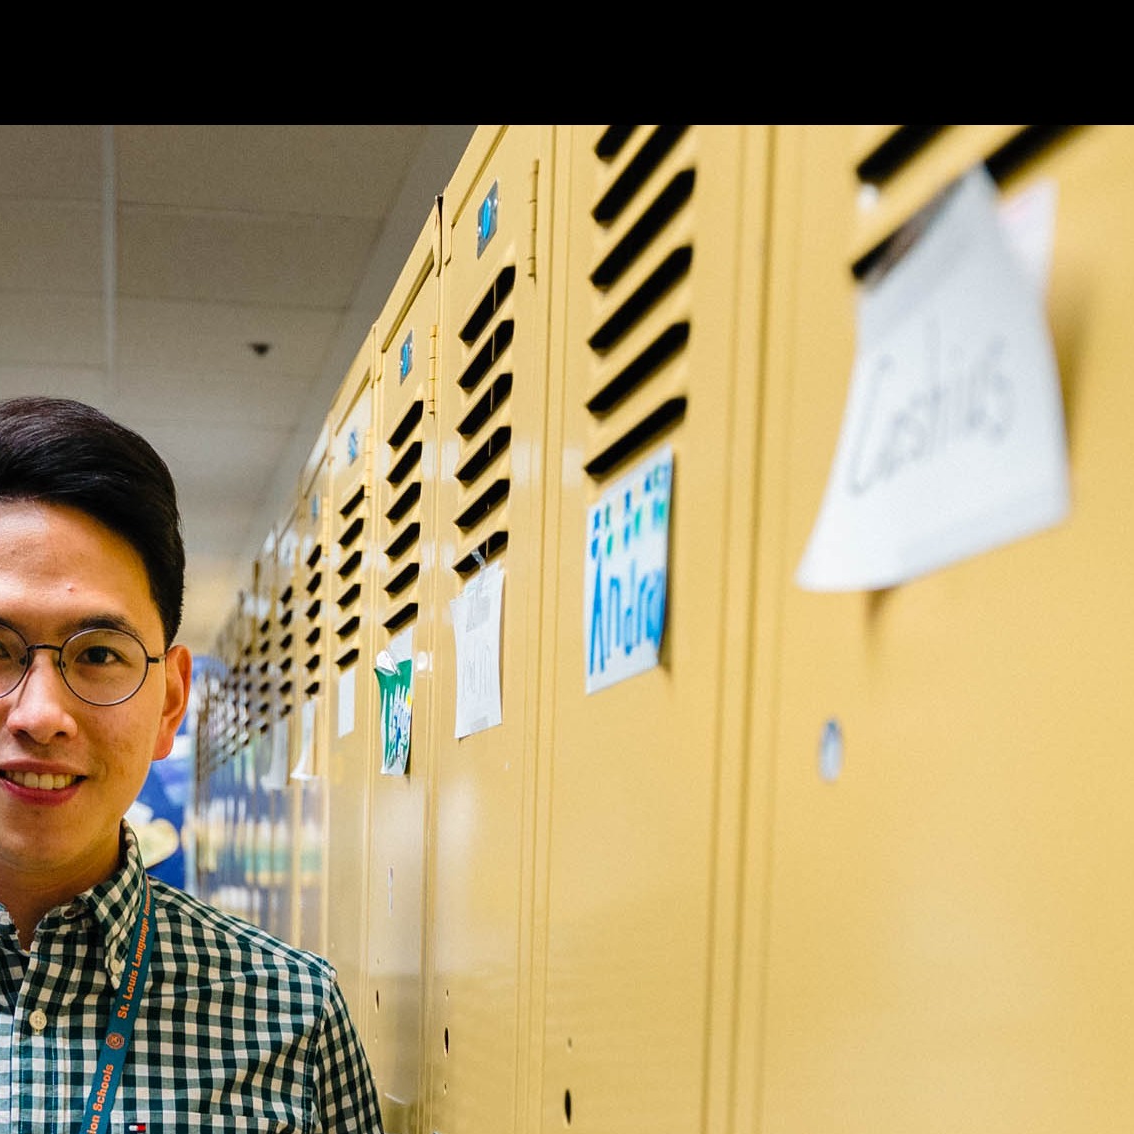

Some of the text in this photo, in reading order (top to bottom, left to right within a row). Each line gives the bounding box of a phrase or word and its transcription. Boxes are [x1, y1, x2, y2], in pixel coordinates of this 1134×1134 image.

[136, 917, 150, 968] Language
[123, 970, 138, 1000] Louis
[117, 1004, 130, 1019] St.
[93, 1064, 113, 1111] Schools
